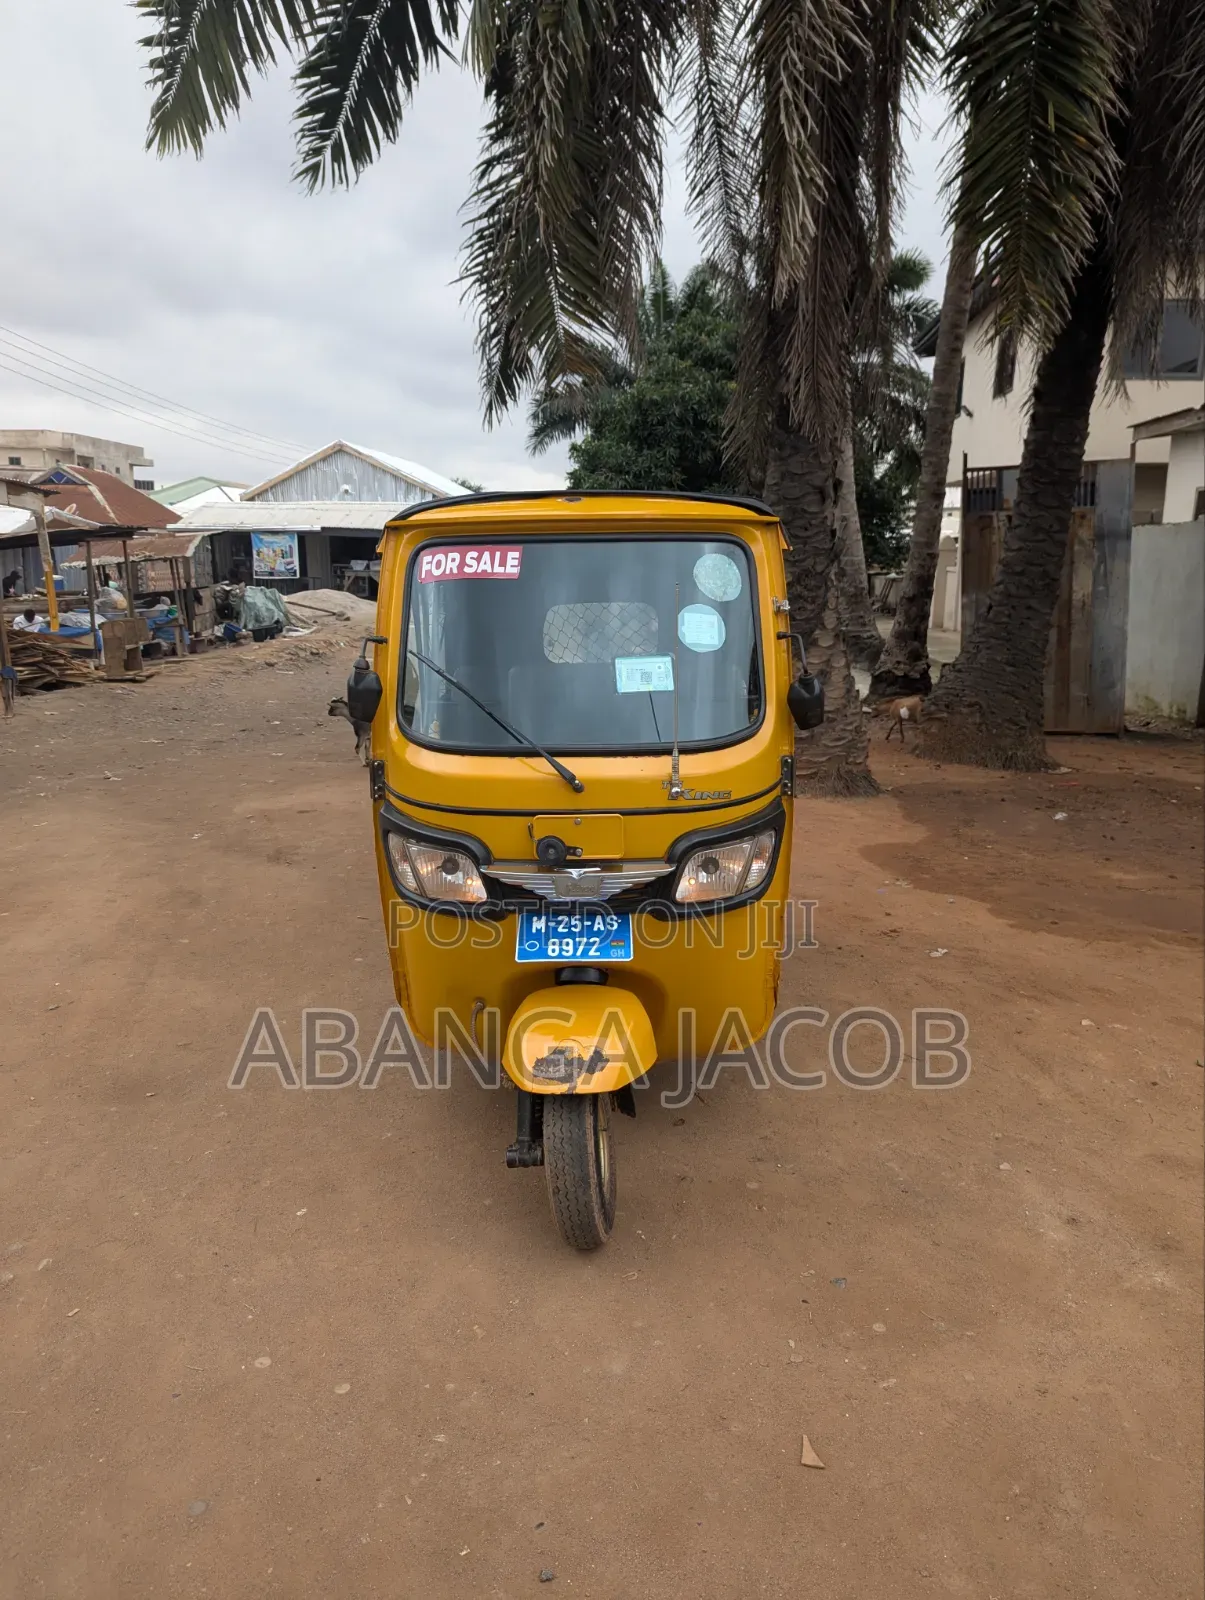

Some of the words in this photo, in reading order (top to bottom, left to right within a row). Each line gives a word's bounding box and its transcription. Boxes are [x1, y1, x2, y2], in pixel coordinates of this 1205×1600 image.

[421, 552, 460, 579] FOR
[463, 550, 520, 574] SALE
[547, 937, 601, 957] 8972
[610, 949, 625, 958] GH
